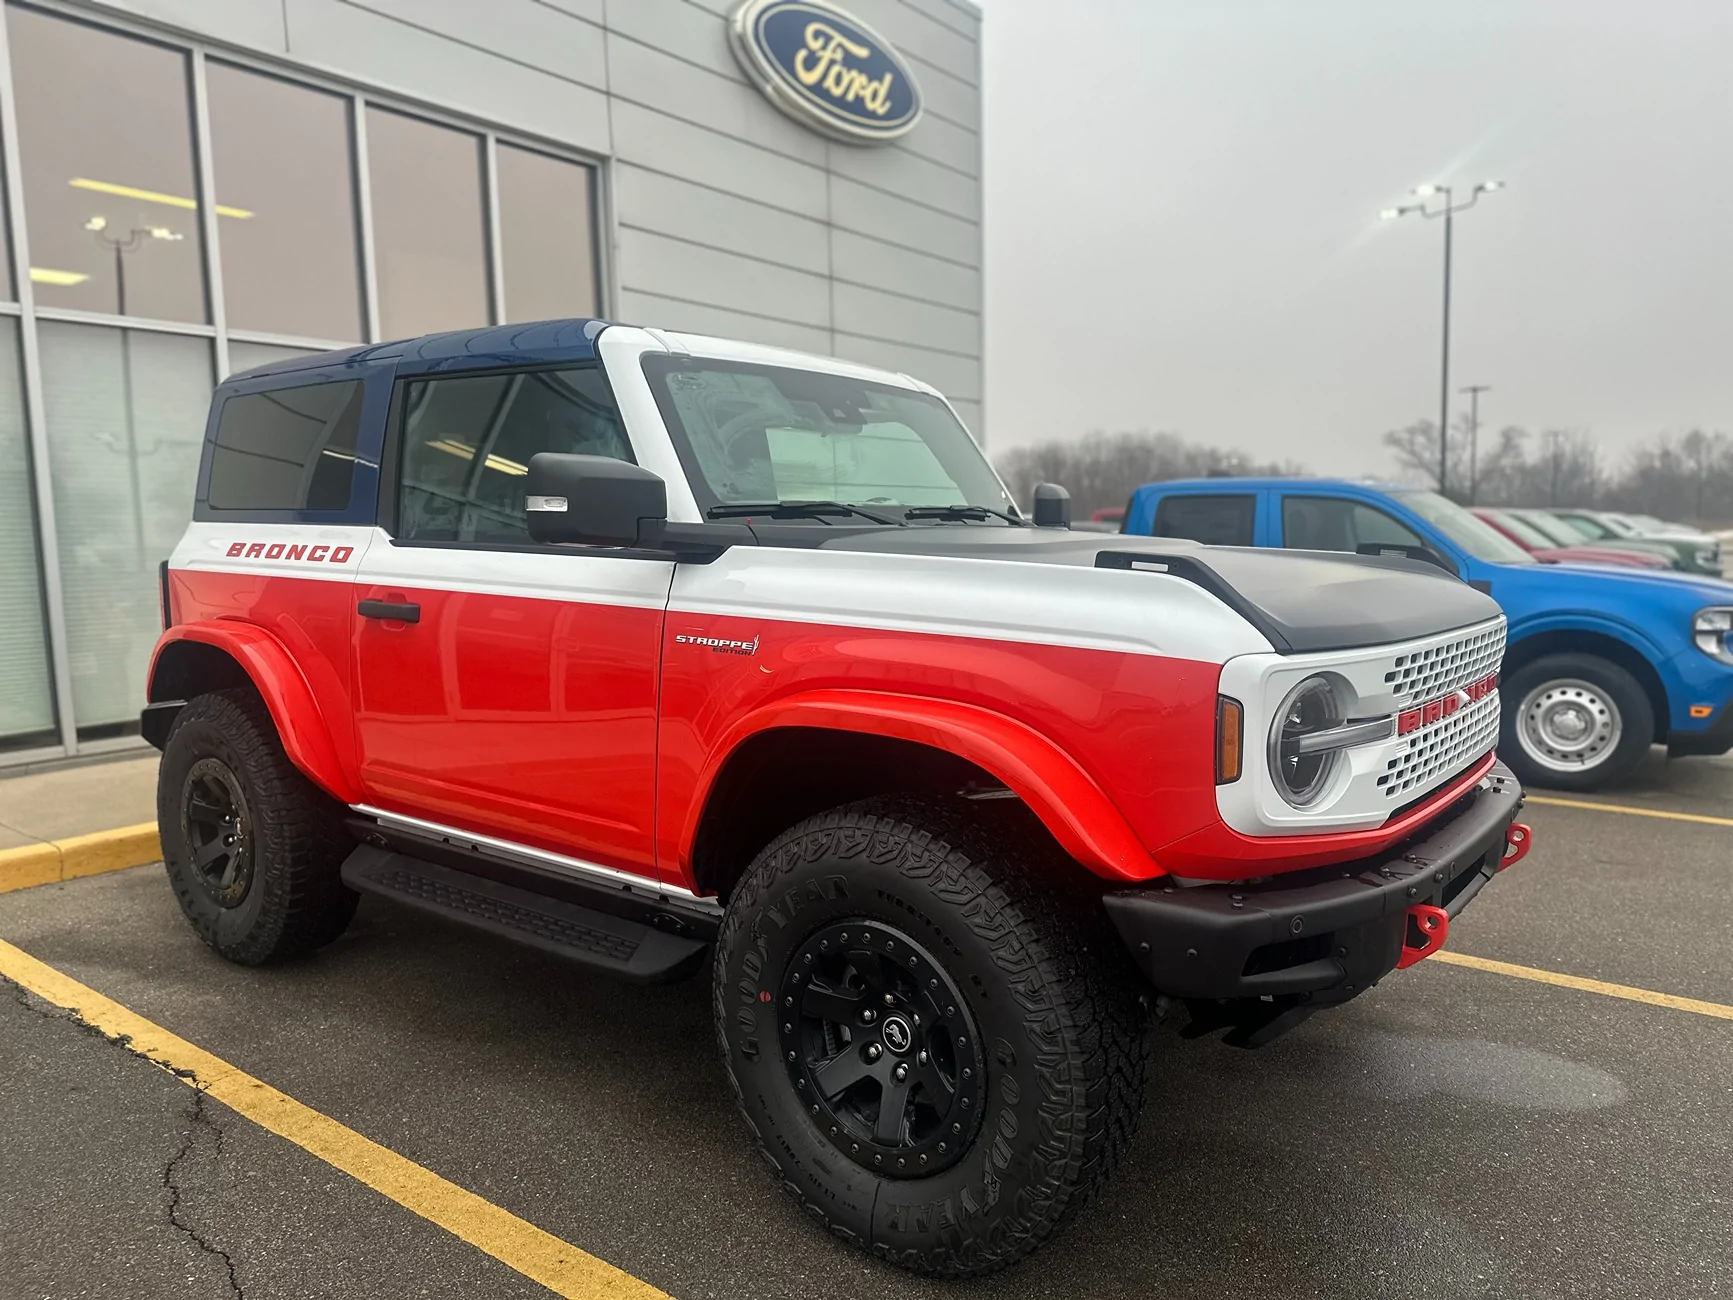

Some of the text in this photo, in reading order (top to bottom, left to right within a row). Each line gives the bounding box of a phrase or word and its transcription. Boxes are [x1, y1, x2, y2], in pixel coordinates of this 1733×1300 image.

[794, 22, 893, 116] Ford
[226, 543, 354, 563] BRONCO
[675, 634, 754, 650] STROPPE
[712, 647, 753, 657] EDITION
